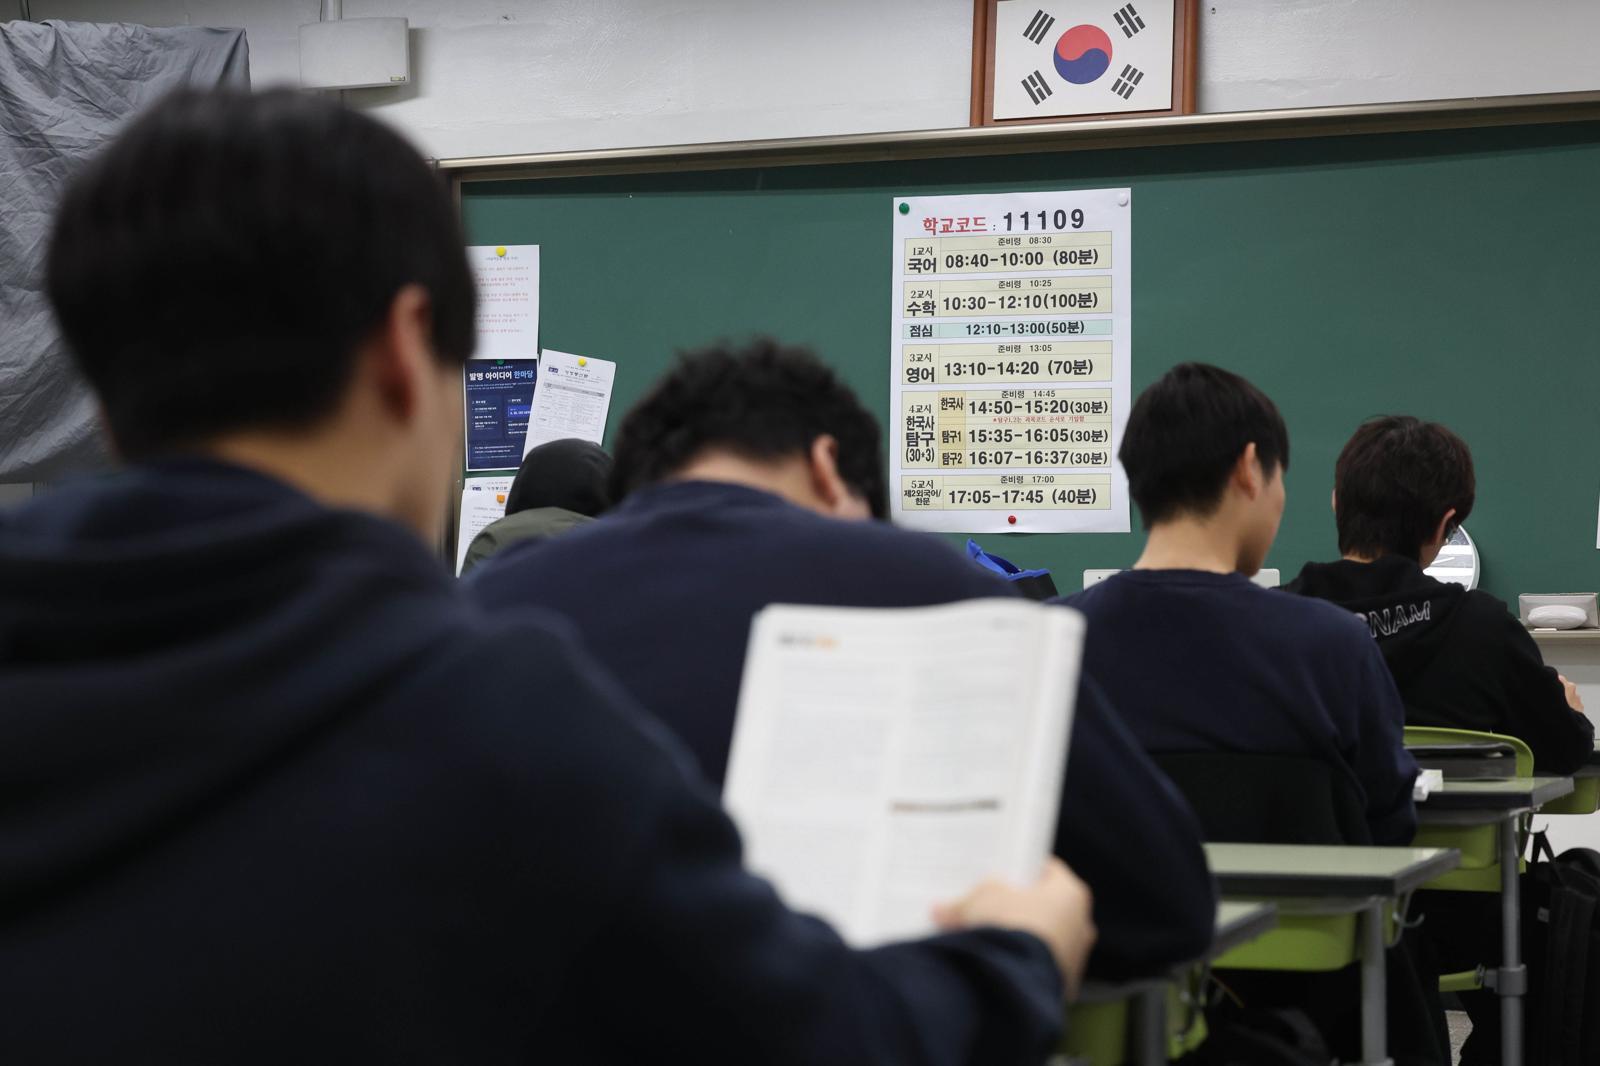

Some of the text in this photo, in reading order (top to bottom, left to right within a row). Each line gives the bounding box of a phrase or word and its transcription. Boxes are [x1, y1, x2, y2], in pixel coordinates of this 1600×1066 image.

[923, 217, 987, 235] 학교코드
[1003, 208, 1085, 231] 11109
[998, 237, 1021, 246] 준비령
[912, 246, 933, 256] 1교시
[945, 249, 1098, 268] 08:40-10:00 (80분)
[908, 258, 937, 273] 국어
[998, 279, 1052, 288] 준비령 10:25
[911, 290, 932, 299] 2교시
[907, 300, 936, 316] 수학
[910, 325, 933, 337] 점심
[998, 344, 1052, 353] 준비령 13:05
[910, 353, 932, 363] 3교시
[945, 359, 1093, 376] 13:10-14:20 (70분)
[469, 370, 534, 381] 발명 아이디어 한마당
[906, 367, 934, 383] 영어
[1002, 390, 1025, 399] 준비령
[909, 404, 931, 414] 4교시
[941, 397, 963, 411] 한국사
[906, 416, 934, 431] 한국사
[906, 432, 935, 447] 탐구
[942, 430, 961, 443] 탐구1
[942, 452, 962, 466] 탐구2
[911, 480, 934, 489] 5교시
[1000, 475, 1054, 484] 준비령 17:00
[915, 497, 930, 506] 한문
[949, 488, 1096, 504] 17:05-17:45 (40분)
[1355, 600, 1431, 638] NAM
